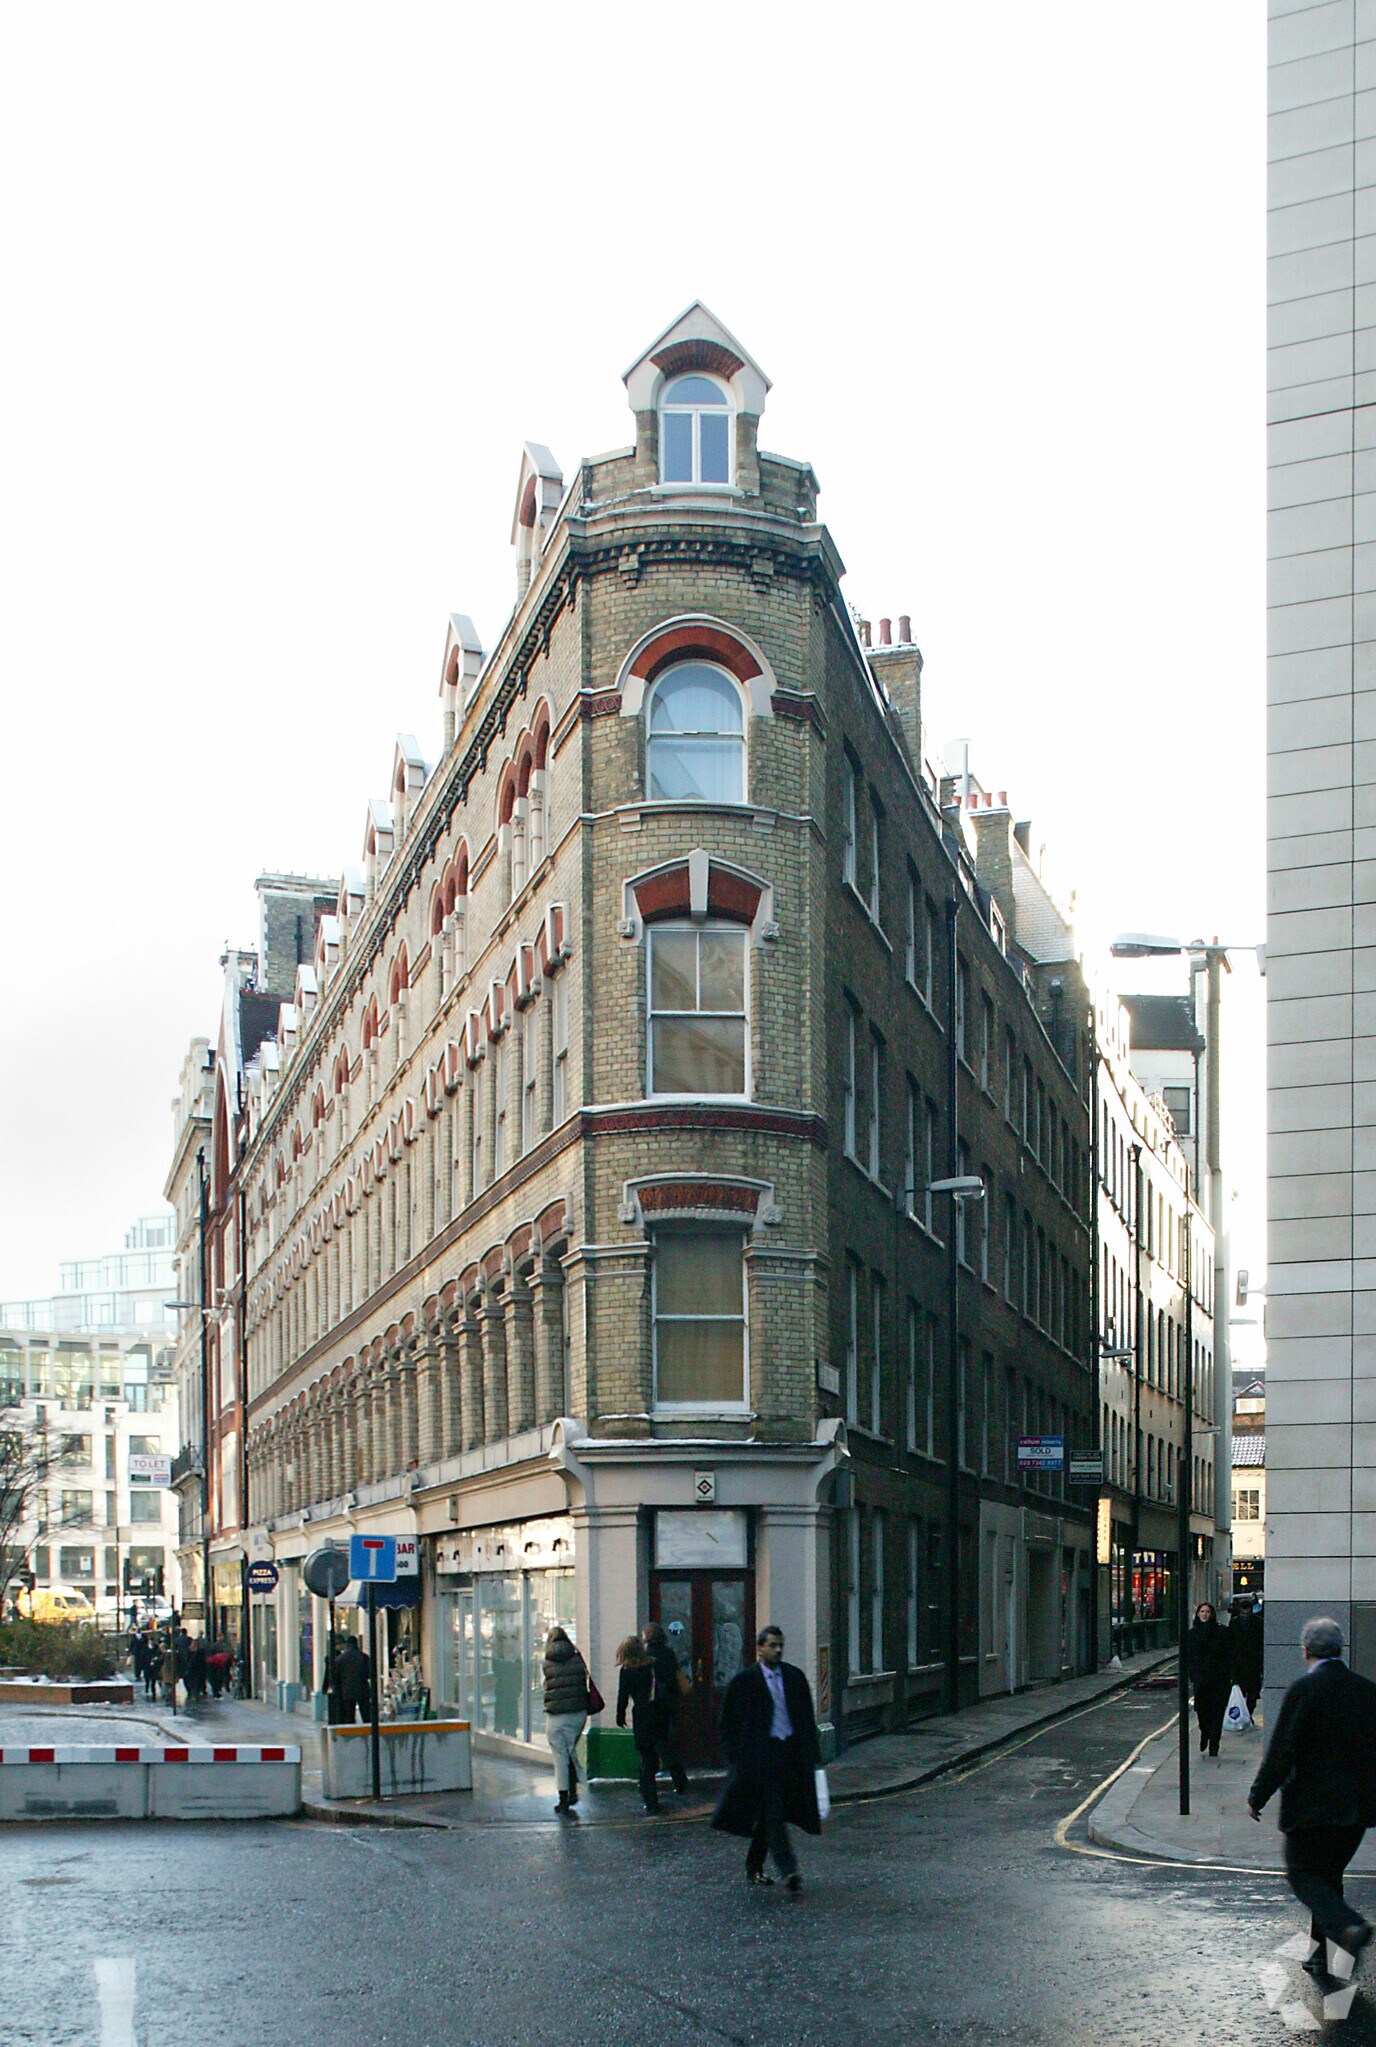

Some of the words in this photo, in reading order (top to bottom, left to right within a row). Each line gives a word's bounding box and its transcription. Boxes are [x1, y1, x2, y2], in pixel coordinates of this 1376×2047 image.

[133, 1460, 147, 1468] TO
[148, 1460, 165, 1468] LET
[397, 1543, 415, 1554] BAR
